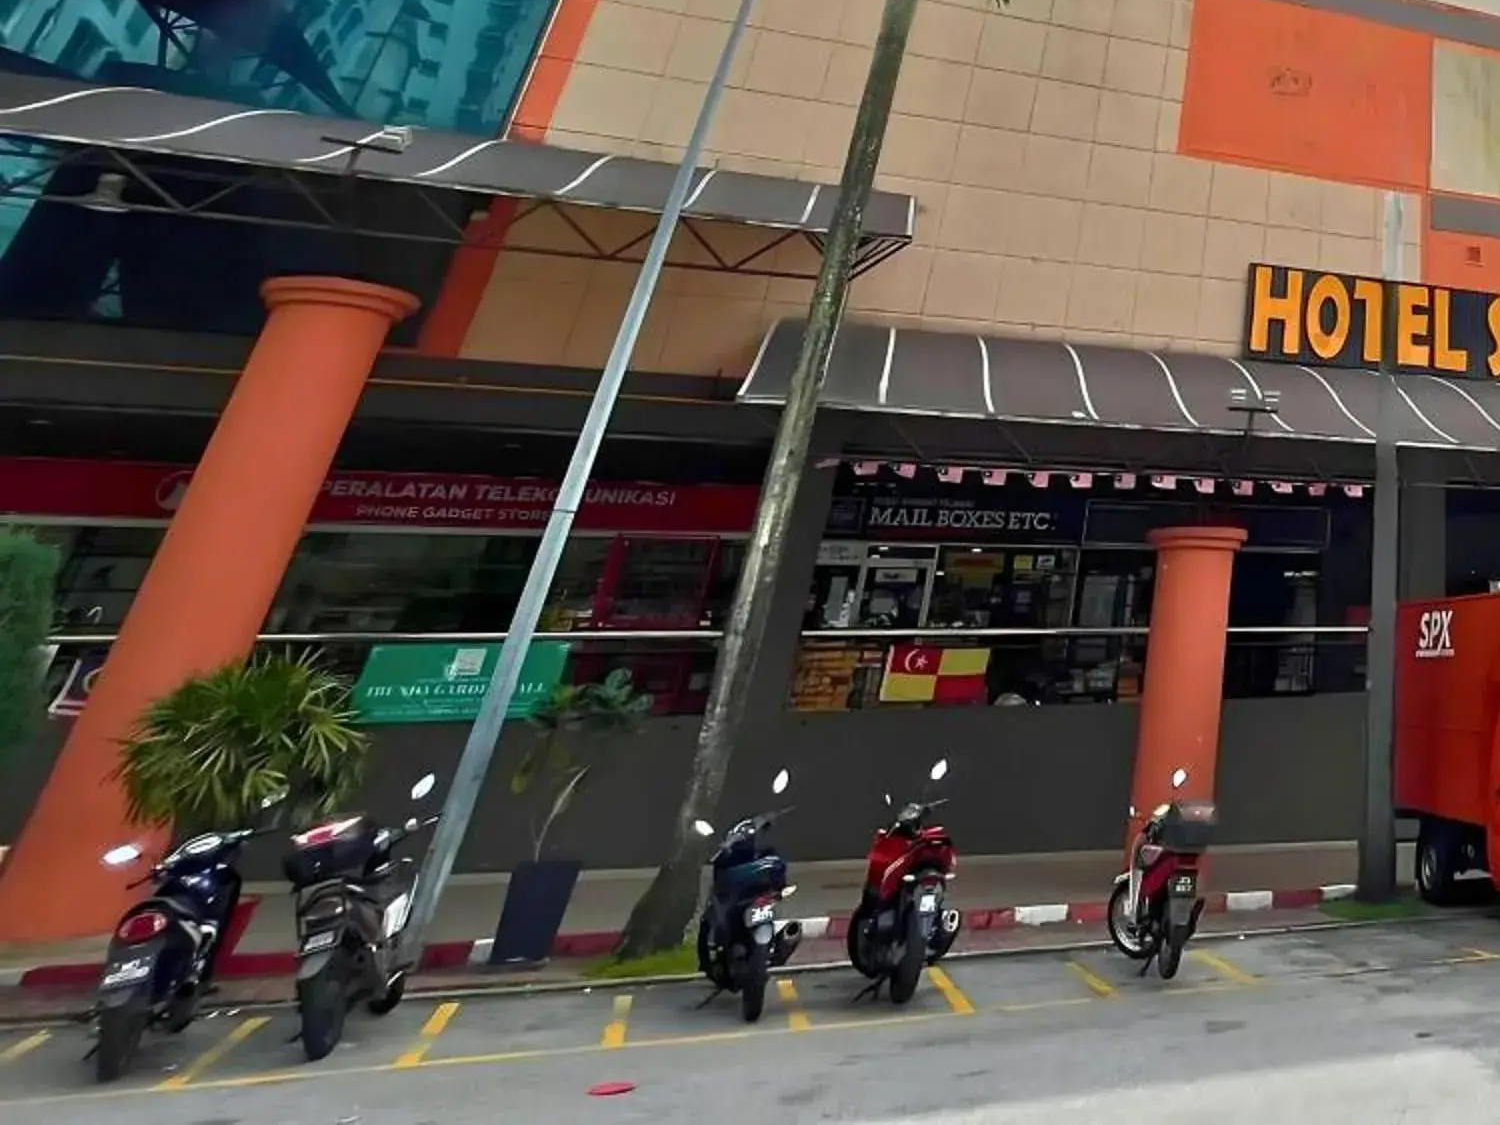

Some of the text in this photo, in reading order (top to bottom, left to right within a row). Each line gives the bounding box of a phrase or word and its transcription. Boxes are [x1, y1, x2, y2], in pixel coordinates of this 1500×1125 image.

[1250, 266, 1468, 373] HOTEL
[322, 479, 676, 507] PERALATAN TELEKOUNIKASI
[356, 504, 419, 518] PHONE
[422, 507, 494, 520] GADGET
[868, 506, 931, 527] MAIL
[936, 510, 1005, 529] BOXES
[1419, 610, 1453, 651] SPX
